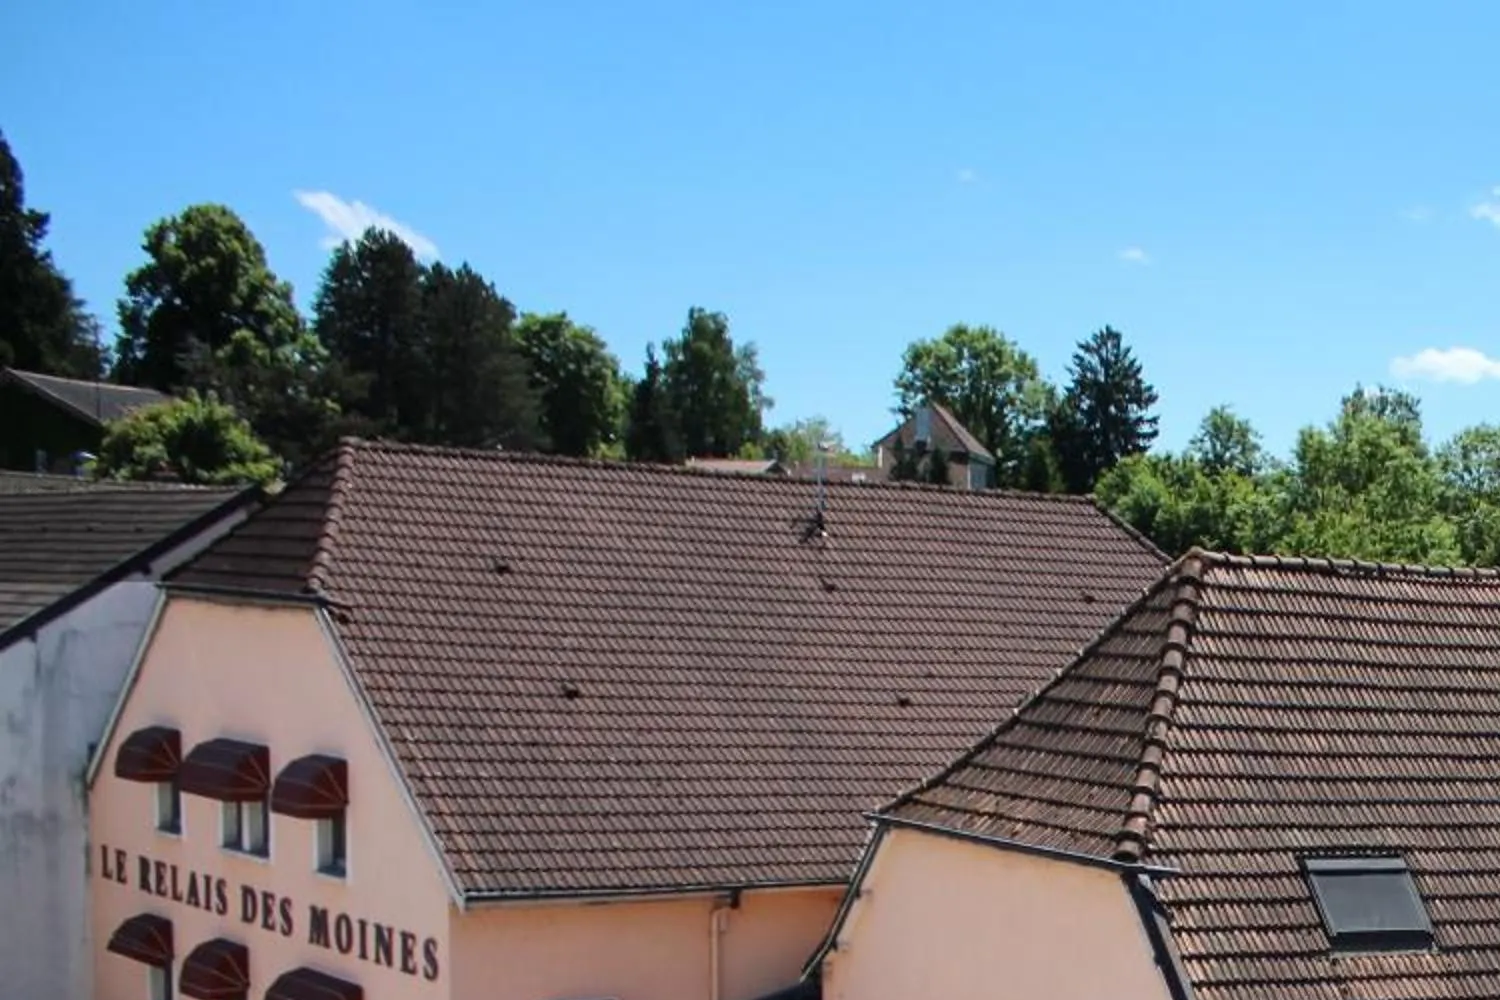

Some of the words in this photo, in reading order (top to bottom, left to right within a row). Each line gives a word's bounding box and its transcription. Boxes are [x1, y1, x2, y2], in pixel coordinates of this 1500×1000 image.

[101, 844, 127, 885] LE
[138, 855, 228, 917] RELAIS
[240, 884, 293, 937] DES
[308, 905, 440, 982] MOINES
